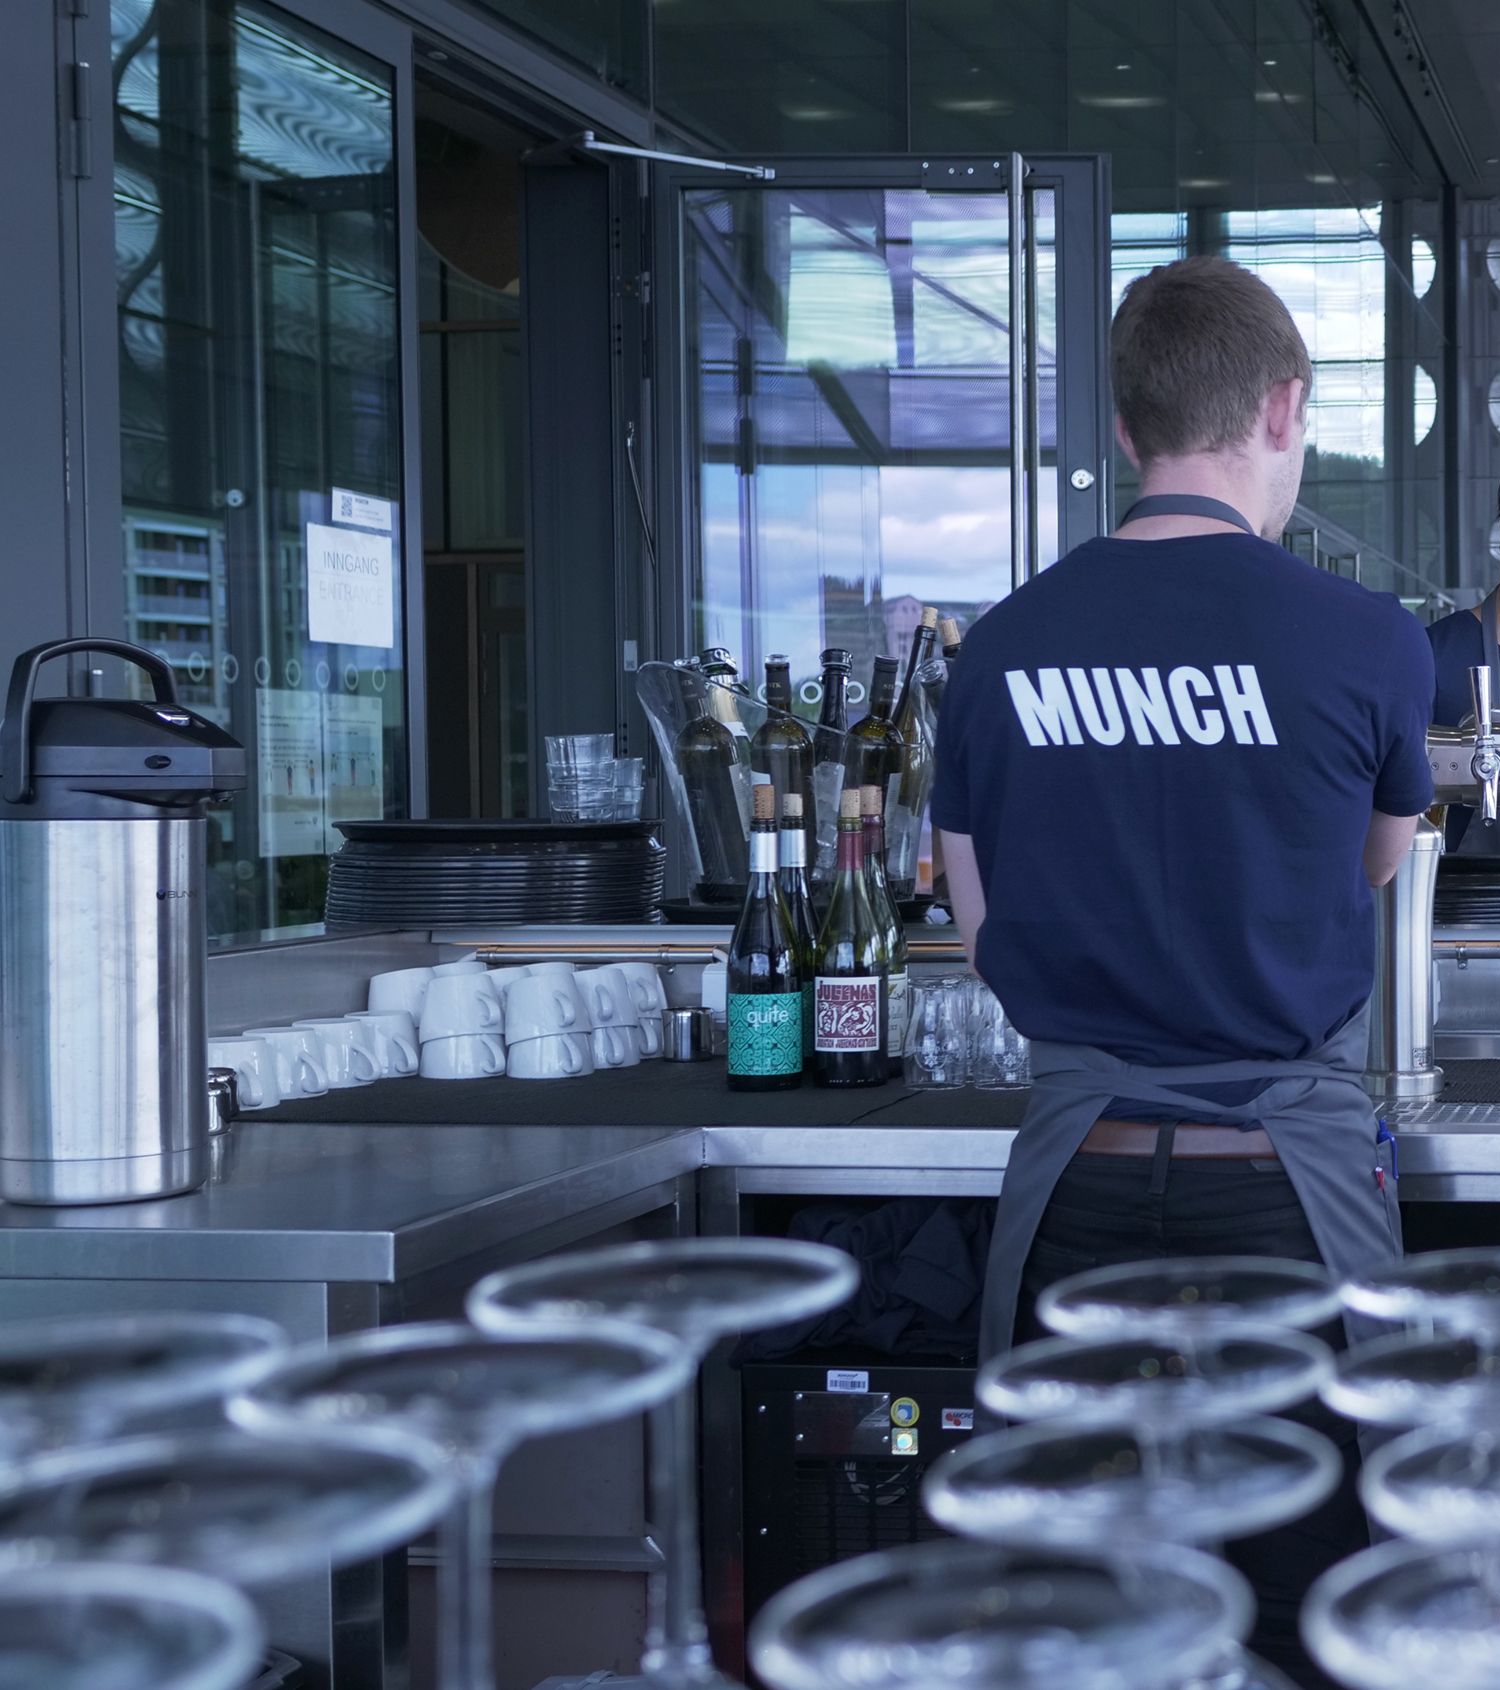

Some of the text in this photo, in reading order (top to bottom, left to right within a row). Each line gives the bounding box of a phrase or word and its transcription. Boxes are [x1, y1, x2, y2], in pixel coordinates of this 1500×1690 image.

[324, 551, 379, 576] INNGANG
[319, 580, 384, 606] ENTRANCE
[1004, 665, 1278, 746] MUNCH
[747, 1004, 789, 1031] quite
